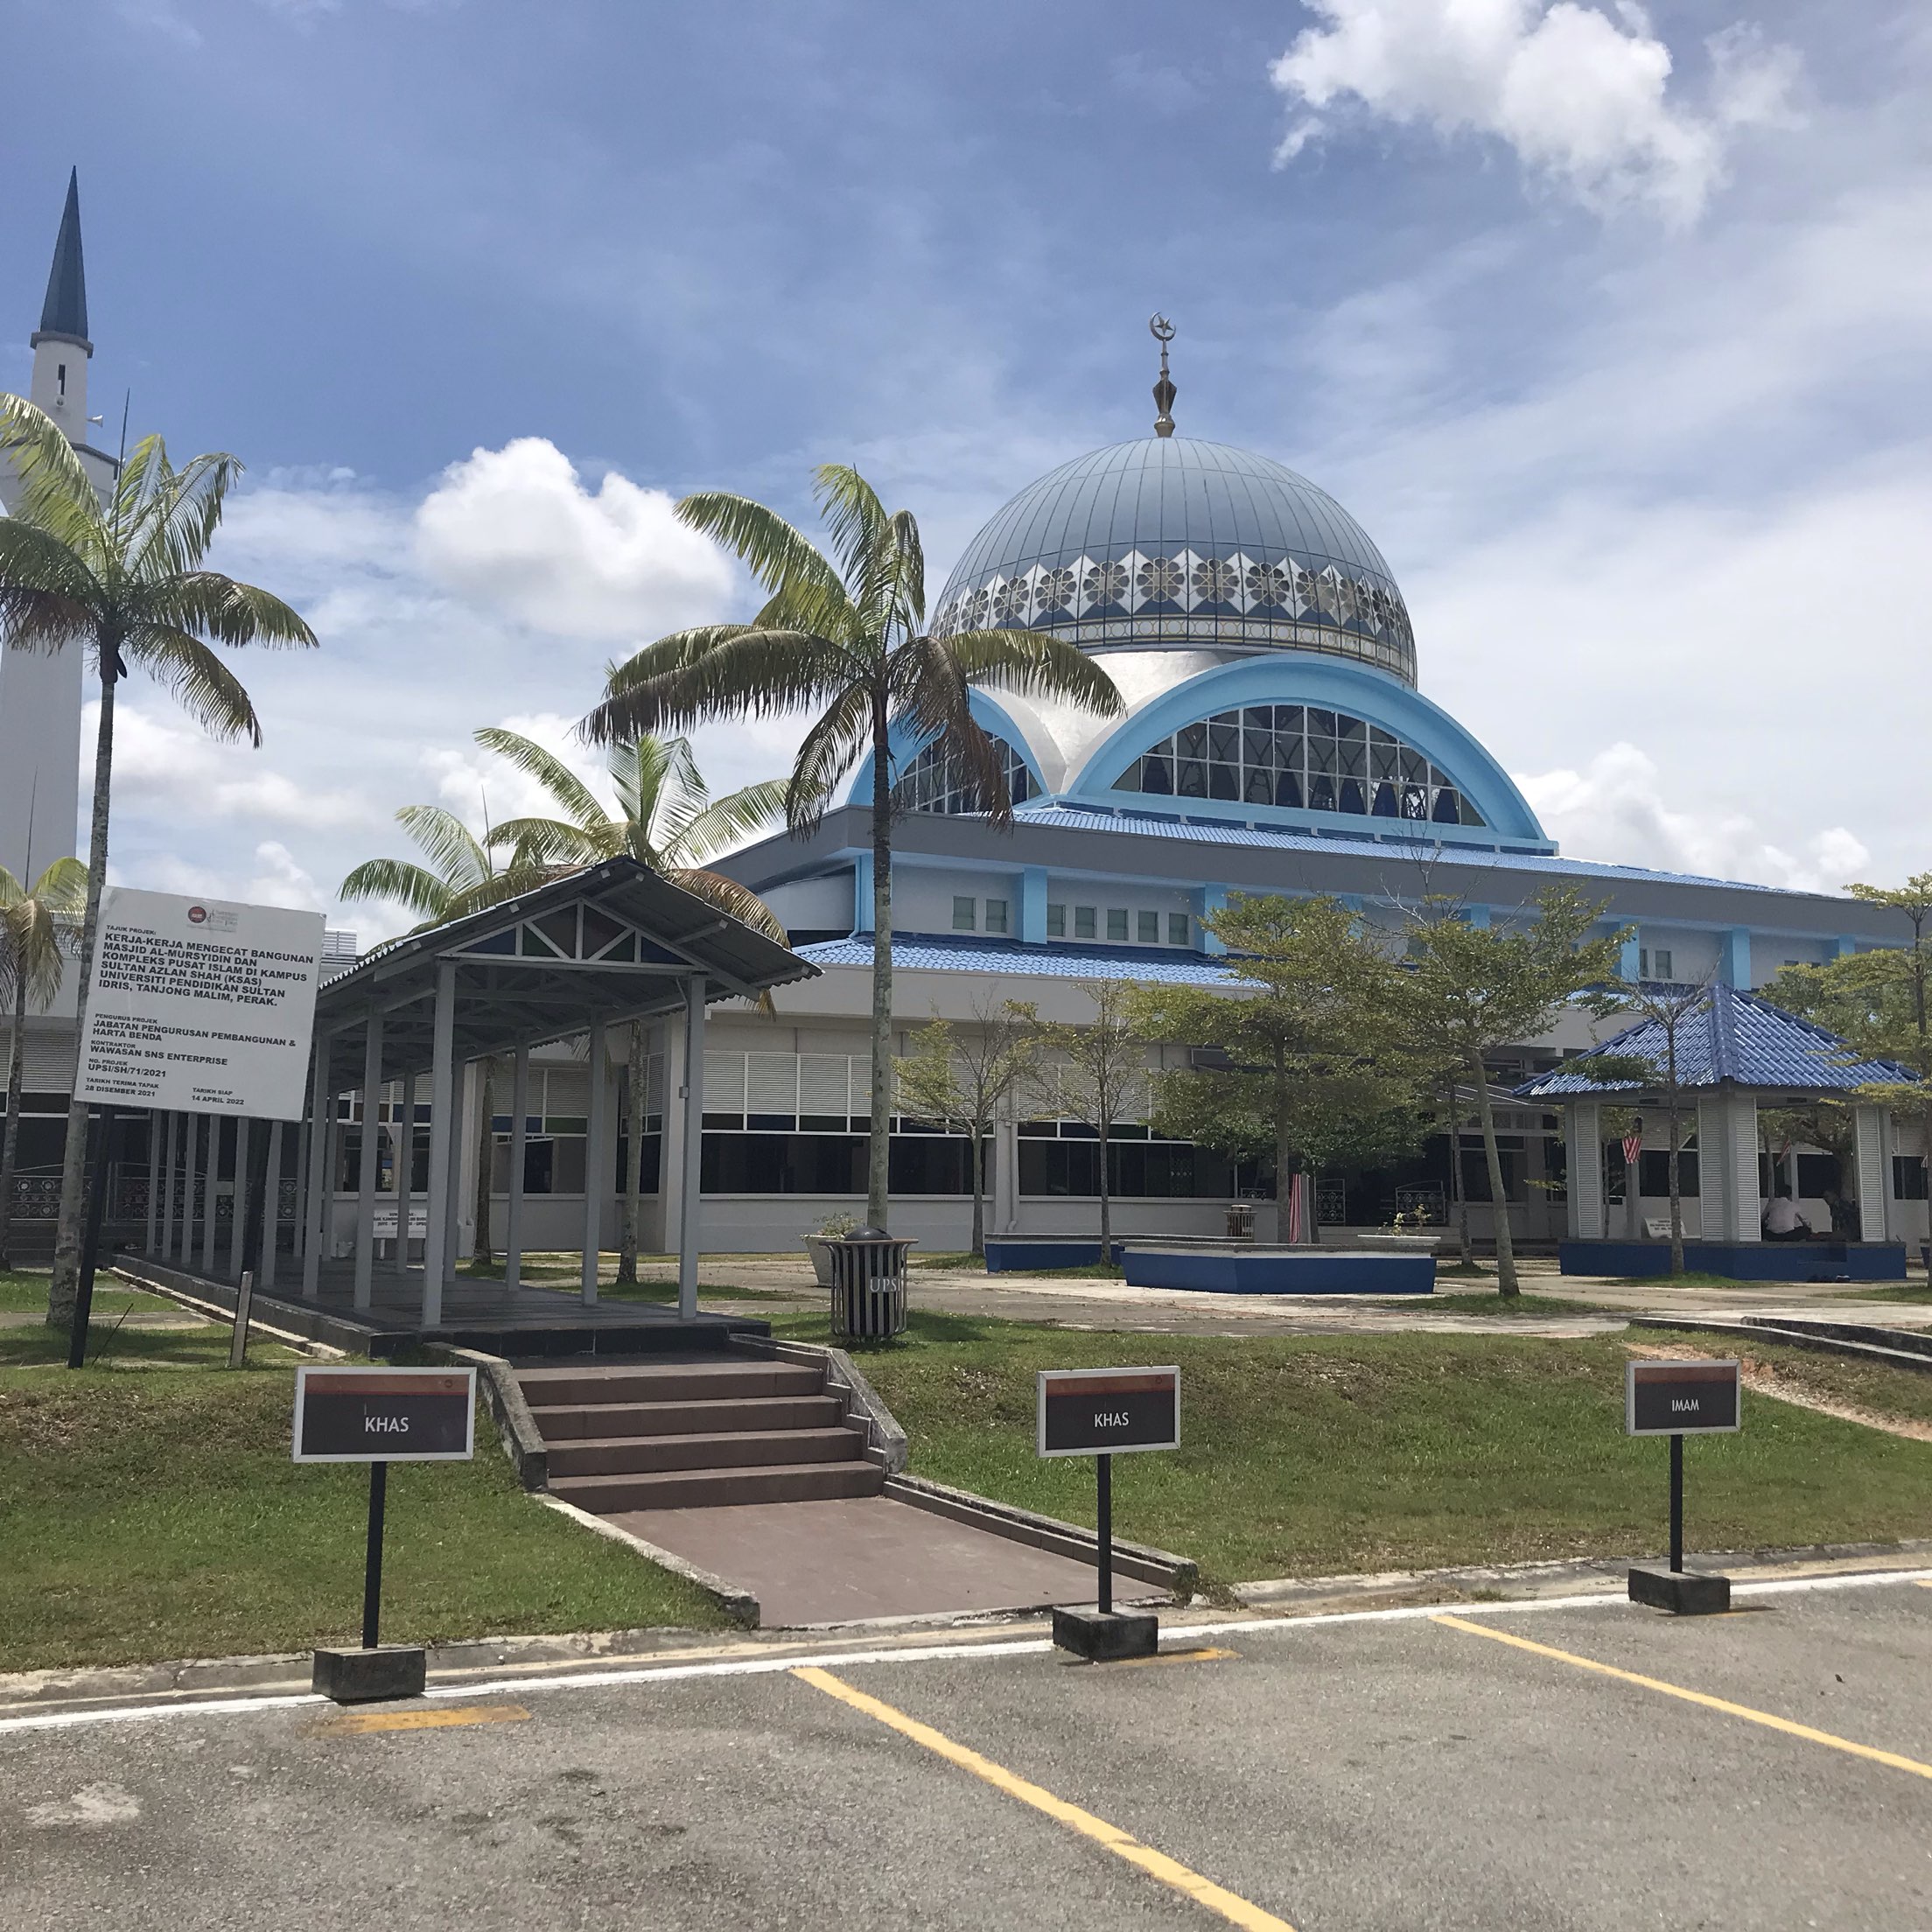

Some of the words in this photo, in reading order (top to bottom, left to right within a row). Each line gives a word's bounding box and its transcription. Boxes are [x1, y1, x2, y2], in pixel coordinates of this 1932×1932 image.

[103, 942, 147, 955] MASJID
[150, 948, 231, 964] AL-MURSYIDIN
[234, 957, 257, 967] DAN
[105, 933, 183, 949] KERJA-KERJA
[186, 942, 248, 956] MENGECAT
[251, 949, 314, 964] BANGUNAN
[101, 961, 146, 973] SULTAN
[149, 966, 187, 977] AZLAN
[190, 970, 221, 981] SHAH
[224, 975, 262, 987] (KSAS)
[102, 951, 165, 966] KOMPLEKS
[168, 958, 206, 970] PUSAT
[208, 963, 242, 975] ISLAM
[246, 968, 257, 976] DI
[261, 970, 308, 982] KAMPUS
[100, 970, 166, 984] UNIVERSITI
[169, 977, 239, 992] PENDIDIKAN
[242, 986, 285, 998] SULTAN
[98, 979, 133, 991] IDRIS,
[136, 984, 191, 997] TANJONG
[193, 990, 234, 1003] MALIM,
[236, 994, 277, 1006] PERAK.
[94, 1013, 131, 1022] PENGURUS
[131, 1016, 158, 1025] PROJEK
[92, 1028, 126, 1038] HARTA
[129, 1031, 163, 1041] BENDA
[93, 1020, 139, 1031] JABATAN
[141, 1024, 209, 1039] PENGURUSAN
[211, 1032, 287, 1046] PEMBANGUNAN
[90, 1040, 136, 1049] KONTRAKTOR
[90, 1045, 142, 1057] WAWASAN
[144, 1050, 164, 1060] SNS
[167, 1053, 228, 1066] ENTERPRISE
[88, 1063, 166, 1078] UPSI/SH/71/2021
[96, 1086, 136, 1096] DISEMBER
[870, 1278, 901, 1292] UPSI
[1671, 1398, 1700, 1412] IMAM
[365, 1417, 410, 1432] KHAS
[1094, 1411, 1130, 1427] KHAS
